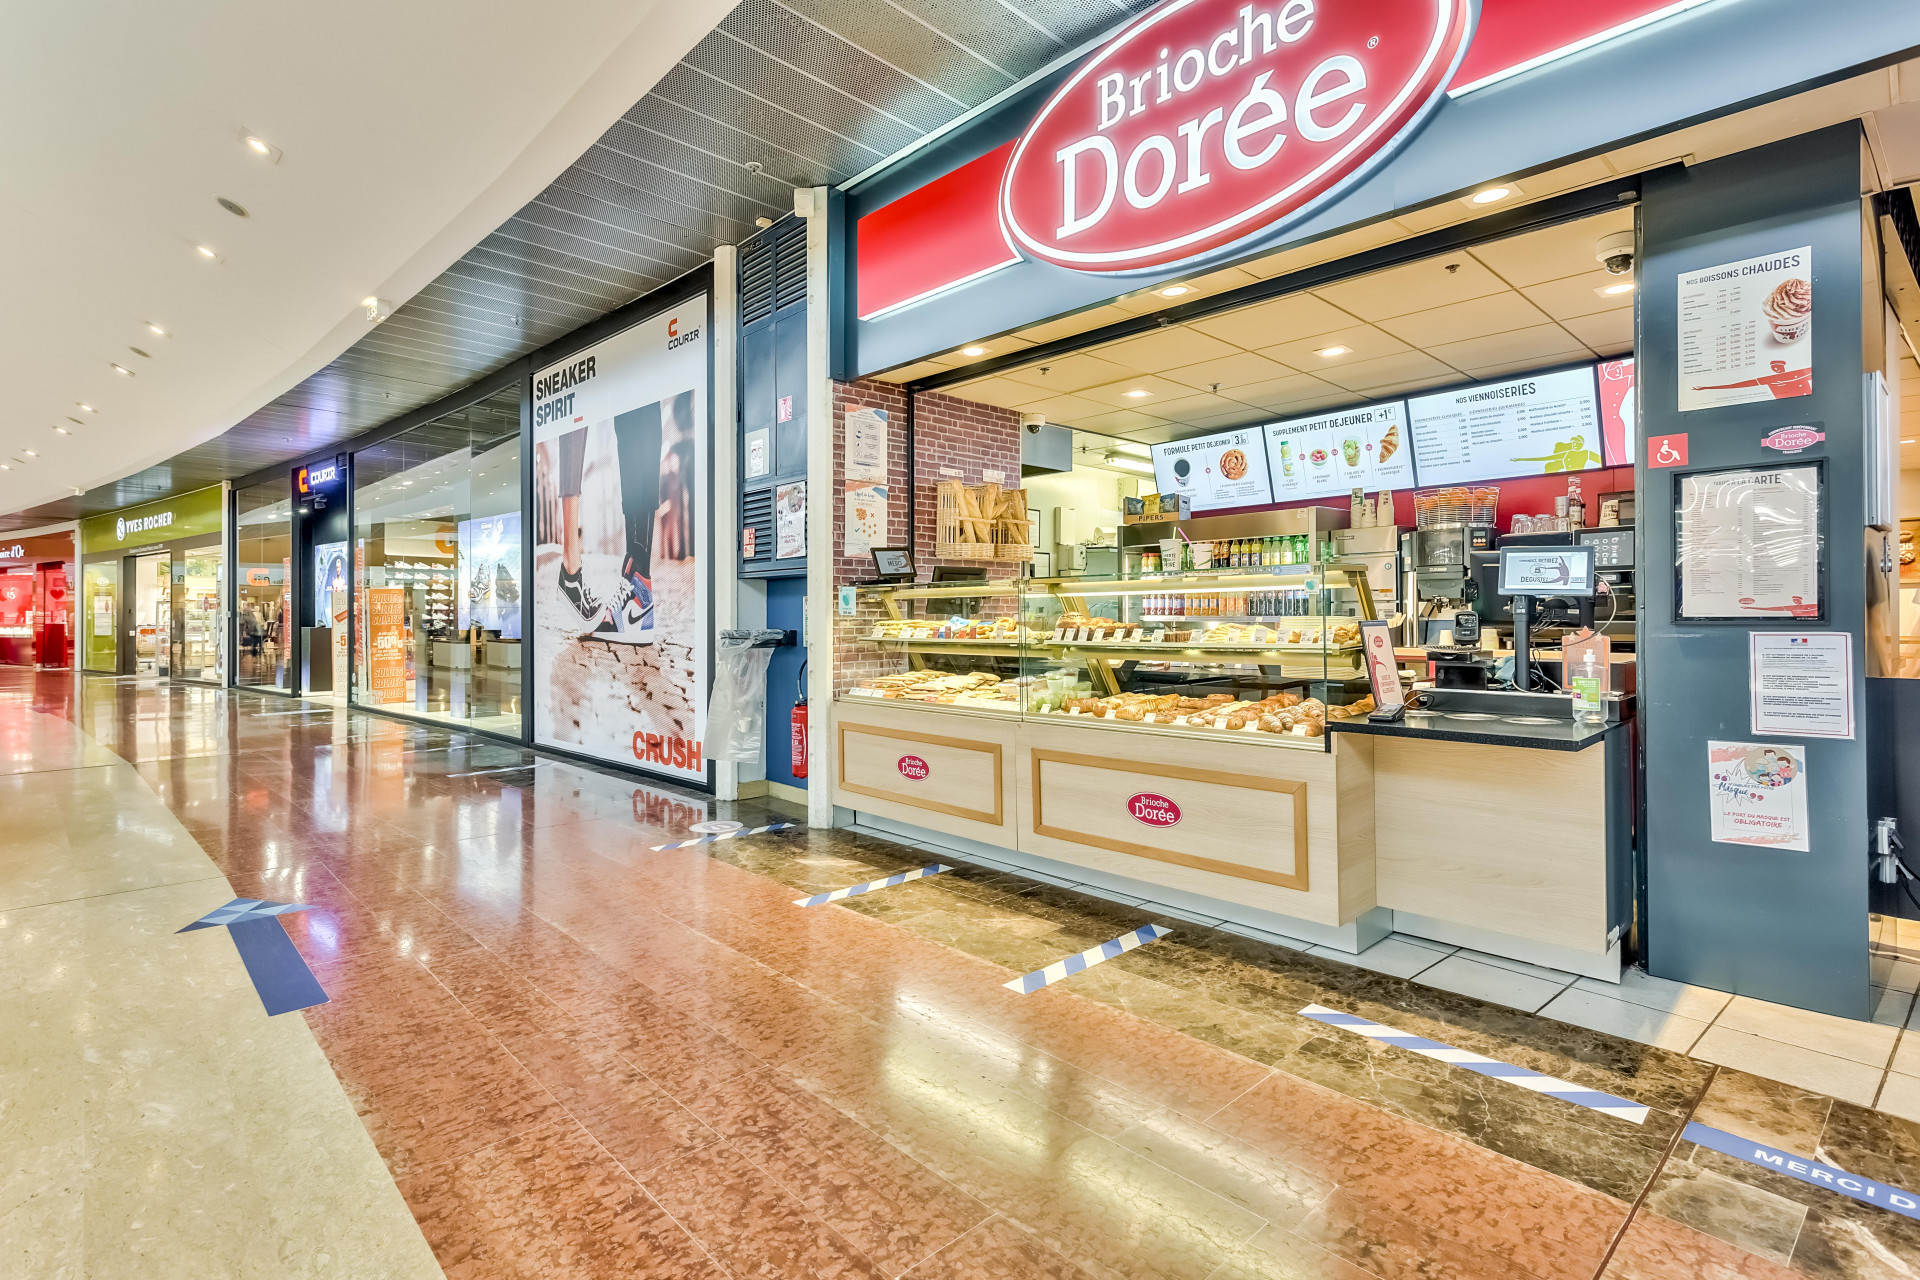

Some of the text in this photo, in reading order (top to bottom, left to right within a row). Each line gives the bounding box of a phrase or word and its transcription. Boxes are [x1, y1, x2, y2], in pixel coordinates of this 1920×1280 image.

[1097, 0, 1315, 132] Brioche
[1056, 54, 1368, 241] Dorée
[1686, 254, 1801, 286] NOS BOISSONS CHAUDES
[667, 328, 699, 351] COURIR
[535, 355, 597, 401] SNEAKER
[1455, 382, 1537, 404] NOS VIENNOISERIES
[535, 392, 576, 427] SPIRIT
[1273, 424, 1308, 437] SUPPLEMENT
[1309, 420, 1328, 432] PETIT
[1330, 412, 1373, 429] DEJEUNER
[1774, 437, 1812, 448] Dorée
[1780, 431, 1807, 439] Brioche
[1163, 444, 1191, 457] FORMULE
[1191, 441, 1206, 452] PETIT
[1206, 438, 1231, 449] DEJEUNER
[310, 465, 336, 485] COURIR
[125, 511, 173, 534] YVES ROCHER
[1138, 514, 1164, 522] PIPERS
[372, 593, 403, 604] SOLDES
[372, 603, 402, 615] SOLDES
[372, 614, 402, 626] SOLDES
[372, 635, 403, 649] -50%
[374, 667, 403, 678] SOLDES
[374, 677, 404, 689] SOLDES
[632, 730, 702, 773] CRUSH
[901, 762, 926, 777] Dorée
[1140, 795, 1169, 809] Brioche
[1134, 802, 1175, 823] Dorée
[1756, 813, 1779, 821] MASQUE
[1733, 818, 1783, 829] OBLIGATOIRE
[1754, 1149, 1877, 1198] MERCI
